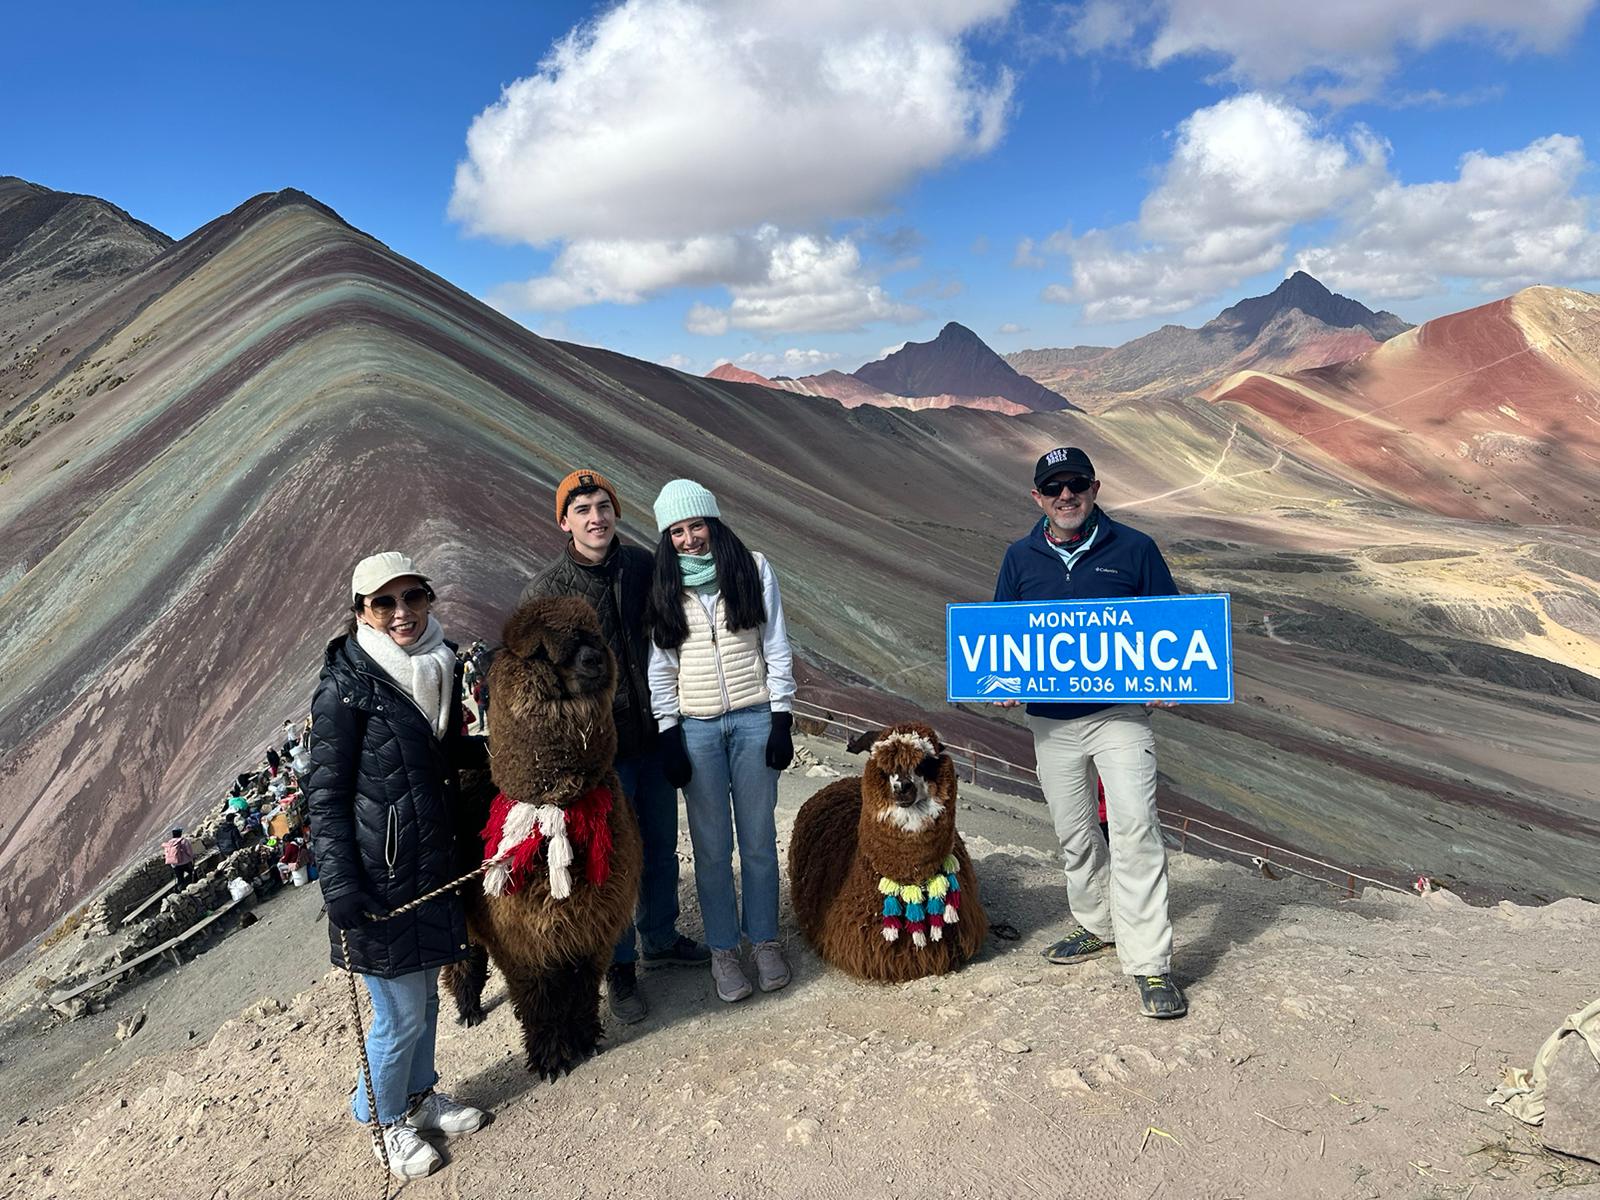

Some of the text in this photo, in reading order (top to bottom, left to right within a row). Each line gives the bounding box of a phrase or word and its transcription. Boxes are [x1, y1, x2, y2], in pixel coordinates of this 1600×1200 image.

[1029, 607, 1133, 628] MONTAÑA
[958, 629, 1218, 672] VINICUNCA
[1026, 676, 1198, 692] ALT. 5036 M.S.N.M.
